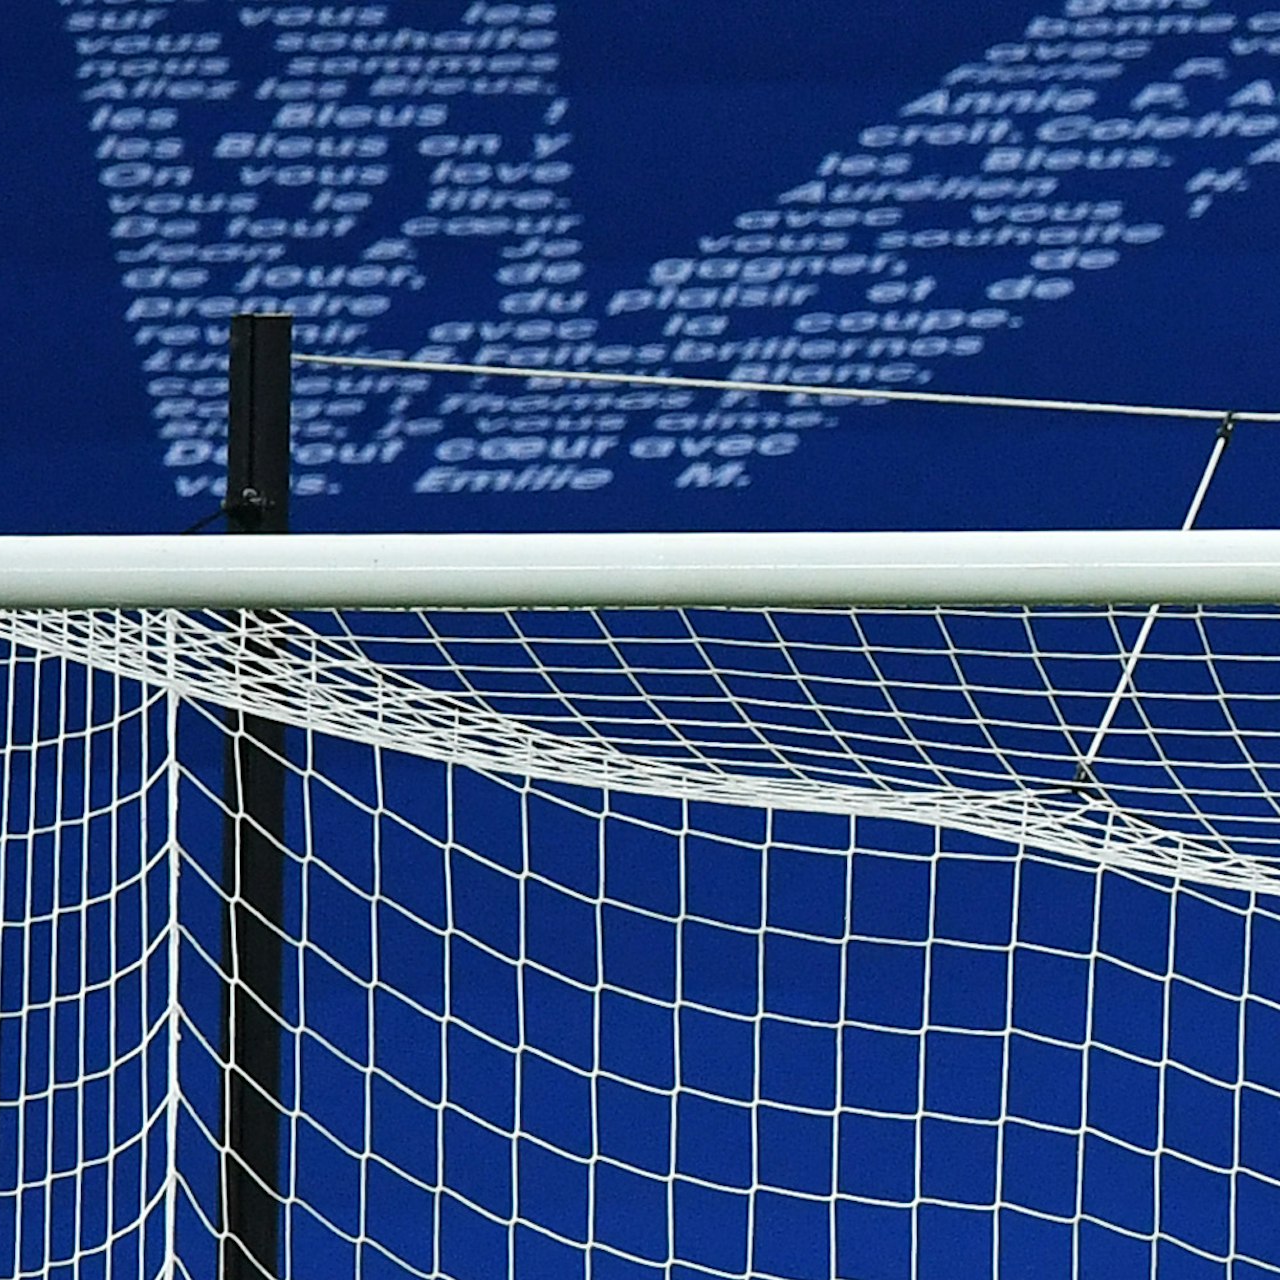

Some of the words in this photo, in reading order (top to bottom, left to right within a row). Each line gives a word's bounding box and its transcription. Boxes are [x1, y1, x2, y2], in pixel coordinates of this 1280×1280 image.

[240, 7, 386, 26] vous
[76, 34, 220, 54] vous
[90, 105, 177, 130] les
[273, 102, 446, 128] Bleus
[96, 135, 181, 159] les
[214, 133, 387, 158] Bleus
[100, 163, 192, 187] On
[240, 165, 388, 185] vous
[109, 193, 257, 213] vous
[123, 266, 208, 288] de
[501, 289, 586, 313] du
[630, 433, 798, 458] avec
